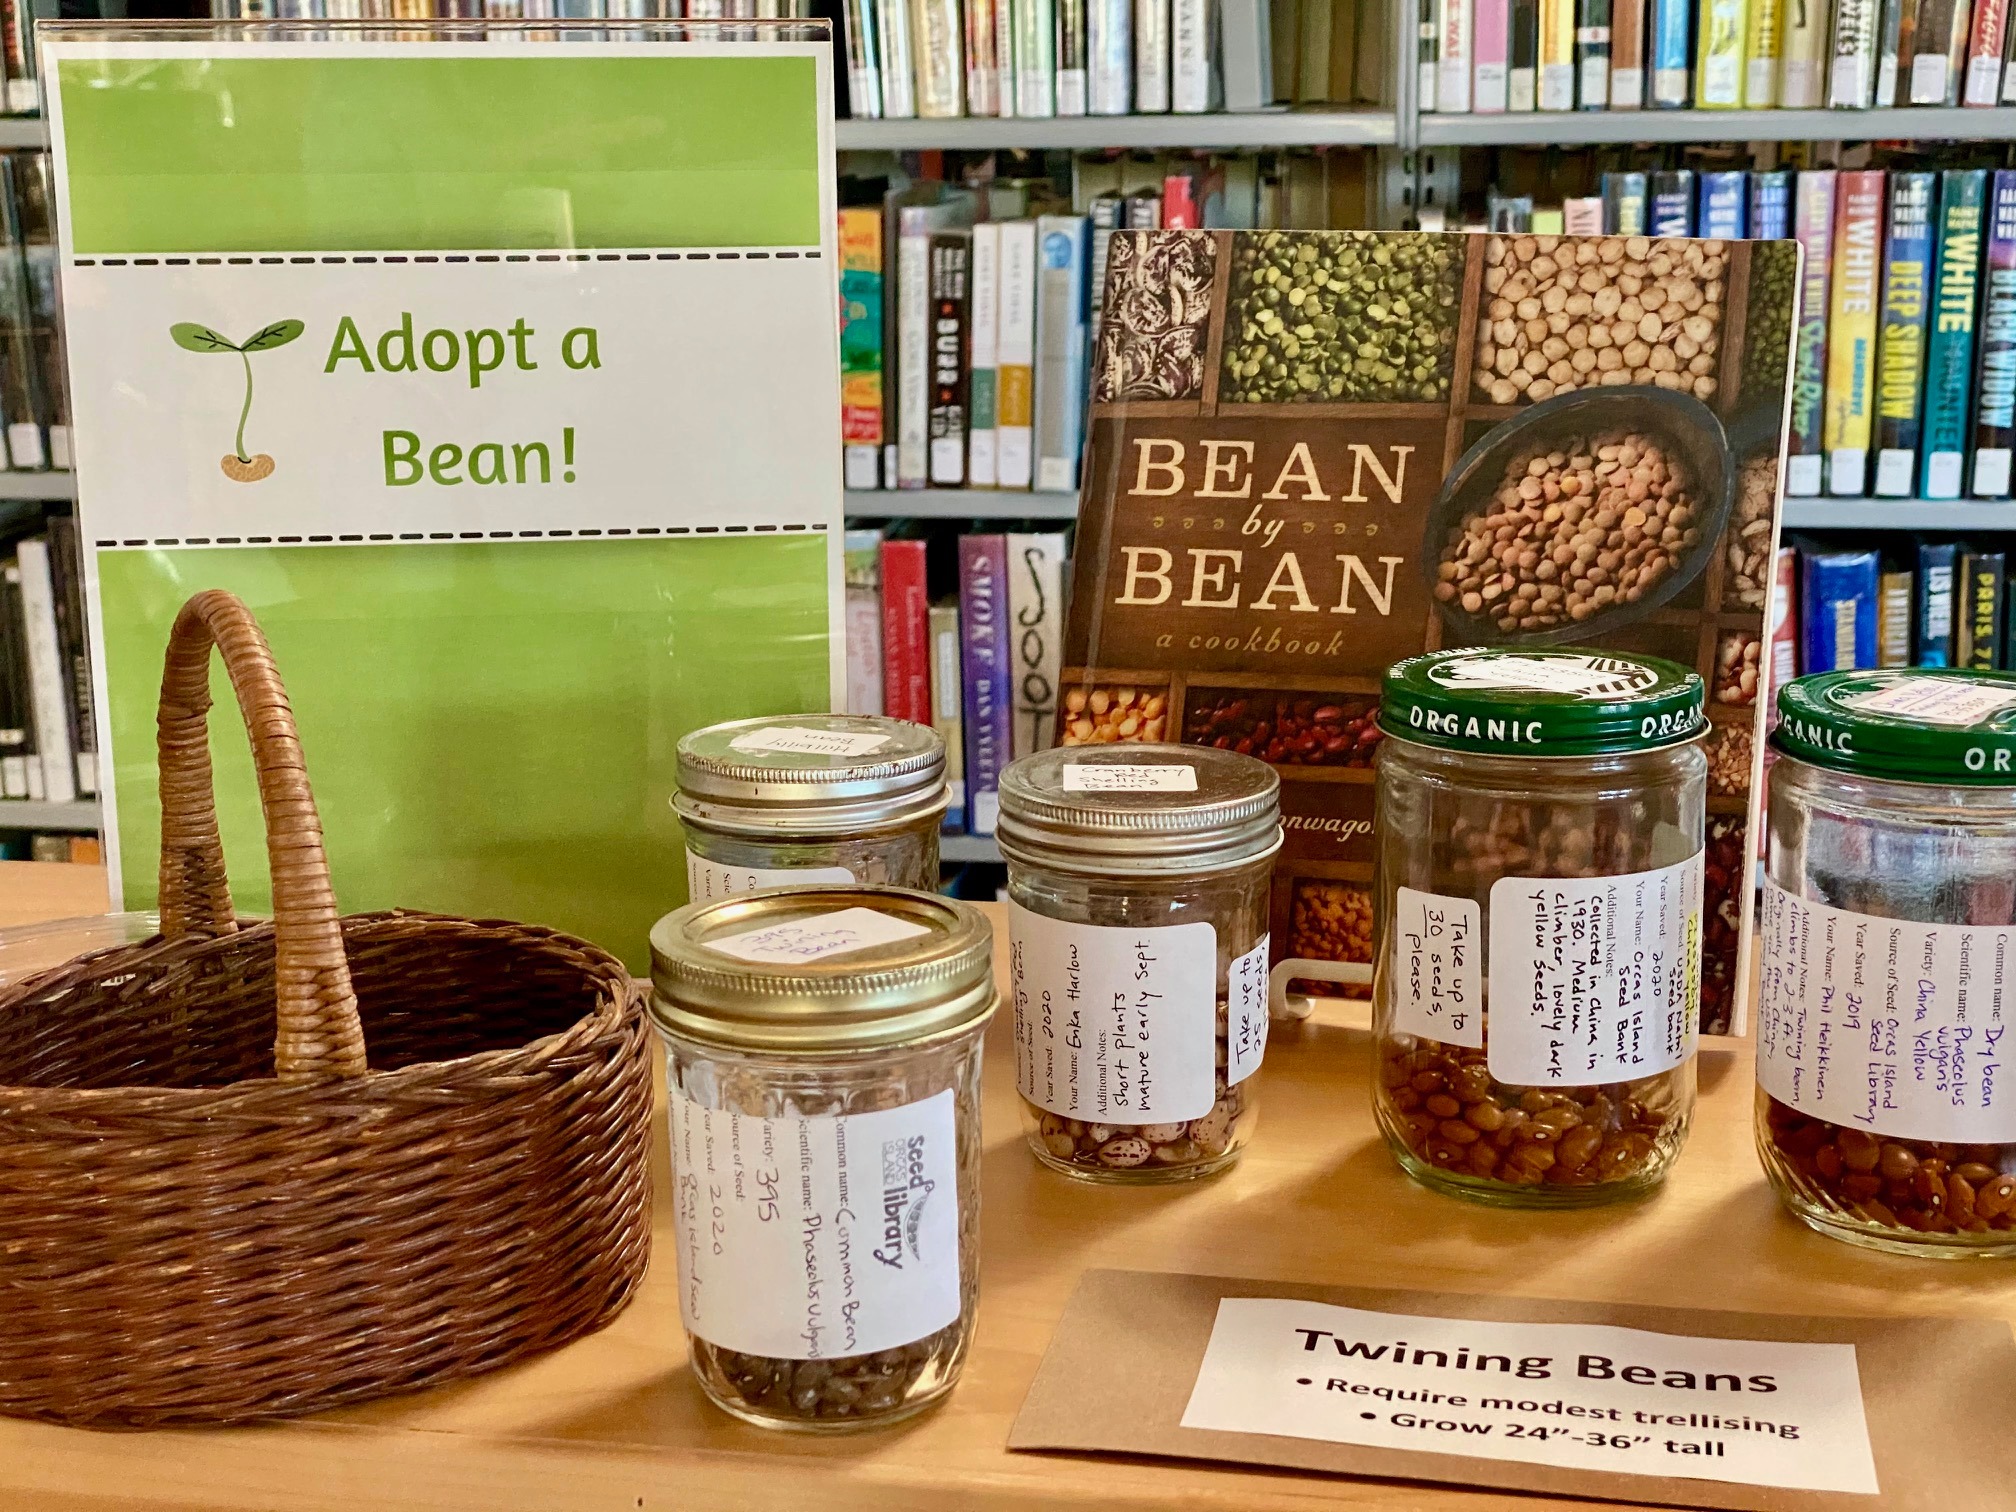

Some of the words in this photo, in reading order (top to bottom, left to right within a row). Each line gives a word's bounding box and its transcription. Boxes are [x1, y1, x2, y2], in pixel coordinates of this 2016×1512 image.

[1843, 219, 1876, 314] WHITE
[1889, 260, 1923, 317] DEEP
[1938, 233, 1978, 333] WHITE
[1985, 269, 2016, 344] BLACK
[323, 311, 539, 388] Adopt
[561, 323, 603, 371] a
[1880, 323, 1919, 419] SHADOW
[1979, 349, 2016, 428] WIDOW
[383, 426, 578, 487] Bean!
[1127, 438, 1416, 504] BEAN
[1241, 503, 1284, 548] by
[1114, 546, 1404, 616] BEAN
[1019, 548, 1054, 753] SOOT
[1155, 634, 1172, 648] a
[1189, 626, 1344, 656] cookbook
[1409, 705, 1544, 744] ORGANIC
[1082, 767, 1185, 776] Cranberry
[1634, 881, 1645, 911] Your
[1658, 875, 1668, 902] Year
[1677, 869, 1686, 907] Source
[1428, 910, 1444, 937] 30
[1528, 889, 1548, 948] yellow
[1548, 893, 1566, 973] climber,
[1571, 899, 1586, 947] 1930.
[1589, 895, 1602, 965] Collected
[1606, 884, 1616, 940] Additional
[1634, 913, 1644, 946] Name:
[1657, 904, 1667, 940] Saved:
[1678, 908, 1685, 922] of
[1772, 891, 1785, 958] Originally
[1788, 901, 1799, 954] climbs
[1825, 916, 1836, 944] Your
[1451, 915, 1469, 969] Take
[1677, 923, 1685, 951] Seed:
[1800, 907, 1810, 965] Additional
[1855, 923, 1866, 951] Year
[1887, 927, 1900, 966] Source
[1921, 932, 1936, 976] Variety:
[1993, 933, 2008, 985] Common
[1067, 944, 1081, 1001] Harlow
[1239, 957, 1251, 976] to
[1405, 933, 1424, 1007] please.
[1589, 975, 1600, 990] in
[1605, 943, 1615, 977] Notes:
[1633, 951, 1644, 1001] Orcas
[1652, 952, 1663, 997] 2020
[1676, 957, 1684, 1004] USDA
[1787, 961, 1796, 975] to
[1824, 946, 1835, 982] Name:
[1853, 953, 1865, 988] Saved:
[1887, 967, 1898, 982] of
[1959, 933, 1972, 987] Scientific
[1242, 982, 1252, 1005] up
[1426, 953, 1445, 1017] seeds,
[1446, 979, 1466, 1003] up
[1571, 960, 1584, 1034] Medium
[1771, 967, 1783, 1002] from
[1781, 983, 1795, 1016] 2-3
[1798, 968, 1808, 1003] Notes:
[1820, 986, 1835, 1014] Phil
[1885, 983, 1897, 1013] Seed:
[1914, 979, 1936, 1023] China
[1956, 989, 1968, 1023] name:
[1992, 987, 2003, 1022] name:
[1042, 990, 1054, 1038] 2020
[1112, 993, 1135, 1049] plants
[1135, 991, 1162, 1041] early
[1452, 1012, 1469, 1031] to
[1540, 984, 1566, 1032] lovely
[1588, 997, 1600, 1046] China
[1842, 992, 1863, 1030] 2019
[1097, 1029, 1107, 1061] Notes:
[1236, 1012, 1251, 1064] Take
[1254, 1022, 1261, 1051] 25
[1616, 1019, 1627, 1065] Bank
[1632, 1011, 1643, 1065] Island
[1786, 1009, 1807, 1060] Twining
[1885, 1018, 1898, 1056] Orcas
[1912, 1030, 1932, 1081] Yellow
[1977, 1025, 2004, 1057] Dry
[1045, 1045, 1054, 1078] Saved:
[1068, 1051, 1078, 1084] Name:
[1135, 1050, 1151, 1111] mature
[1550, 1039, 1563, 1078] dark
[1587, 1053, 1603, 1070] in
[1816, 1022, 1831, 1101] Heikkinen
[1928, 1025, 1949, 1092] vulgaris
[1952, 1026, 1972, 1106] Phaseolus
[1045, 1079, 1055, 1104] Year
[1070, 1086, 1079, 1111] Your
[1097, 1063, 1107, 1116] Additional
[1853, 1062, 1883, 1125] Library
[1883, 1064, 1896, 1109] Island
[1981, 1064, 2001, 1108] bean
[706, 1136, 715, 1174] Saved:
[734, 1156, 742, 1168] of
[908, 1135, 934, 1192] seed
[734, 1169, 744, 1202] Seed:
[756, 1168, 779, 1222] 395
[802, 1174, 812, 1211] name:
[837, 1172, 848, 1207] name:
[710, 1184, 723, 1256] 2020
[873, 1187, 908, 1270] library
[802, 1216, 821, 1299] Phaseolus
[835, 1208, 856, 1296] Common
[842, 1301, 859, 1351] Bean
[1293, 1327, 1553, 1381] Twining
[1576, 1352, 1781, 1395] Beans
[1325, 1377, 1469, 1410] Require
[1479, 1395, 1622, 1423] modest
[1630, 1403, 1801, 1441] trellising
[1389, 1410, 1494, 1436] Grow
[1662, 1437, 1725, 1459] tall
